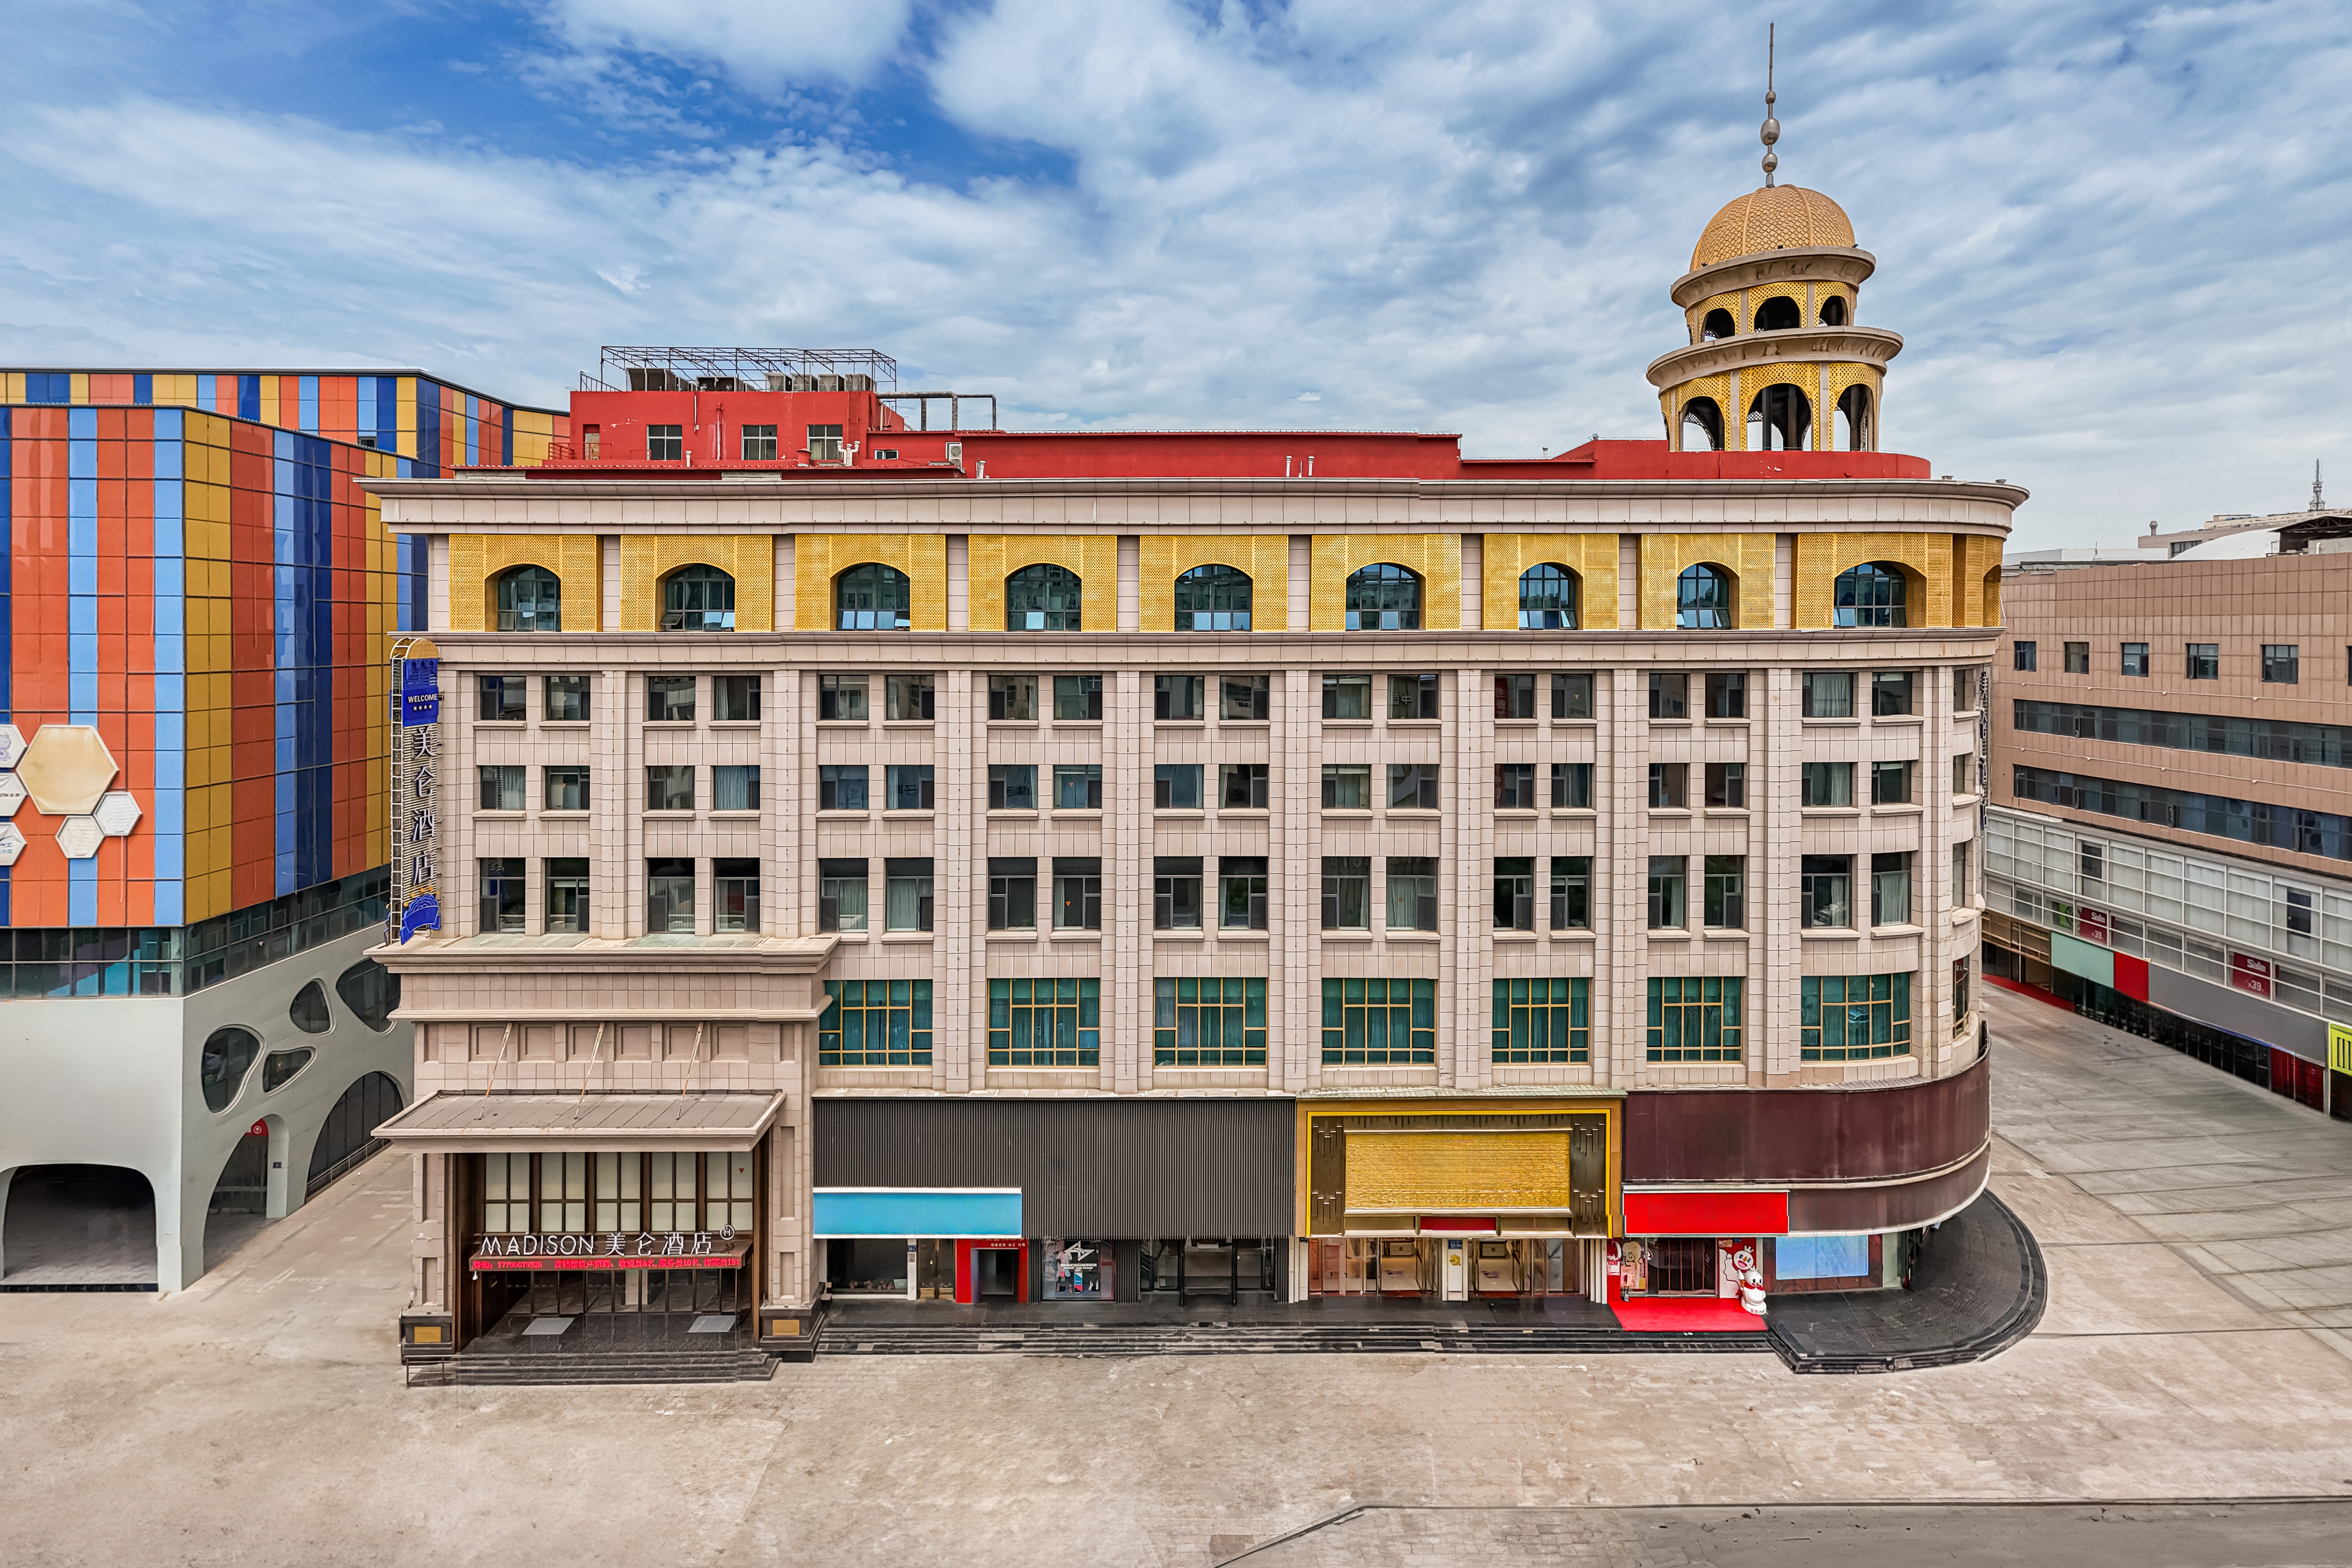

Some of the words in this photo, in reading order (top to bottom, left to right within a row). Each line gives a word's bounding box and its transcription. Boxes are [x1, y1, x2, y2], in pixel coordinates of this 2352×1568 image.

[408, 693, 437, 703] WELCOME
[413, 727, 436, 885] 美仑酒店
[2091, 912, 2105, 924] Sale
[2247, 958, 2266, 972] Sale
[481, 1235, 594, 1256] MADISON
[605, 1231, 712, 1256] 美仑酒店
